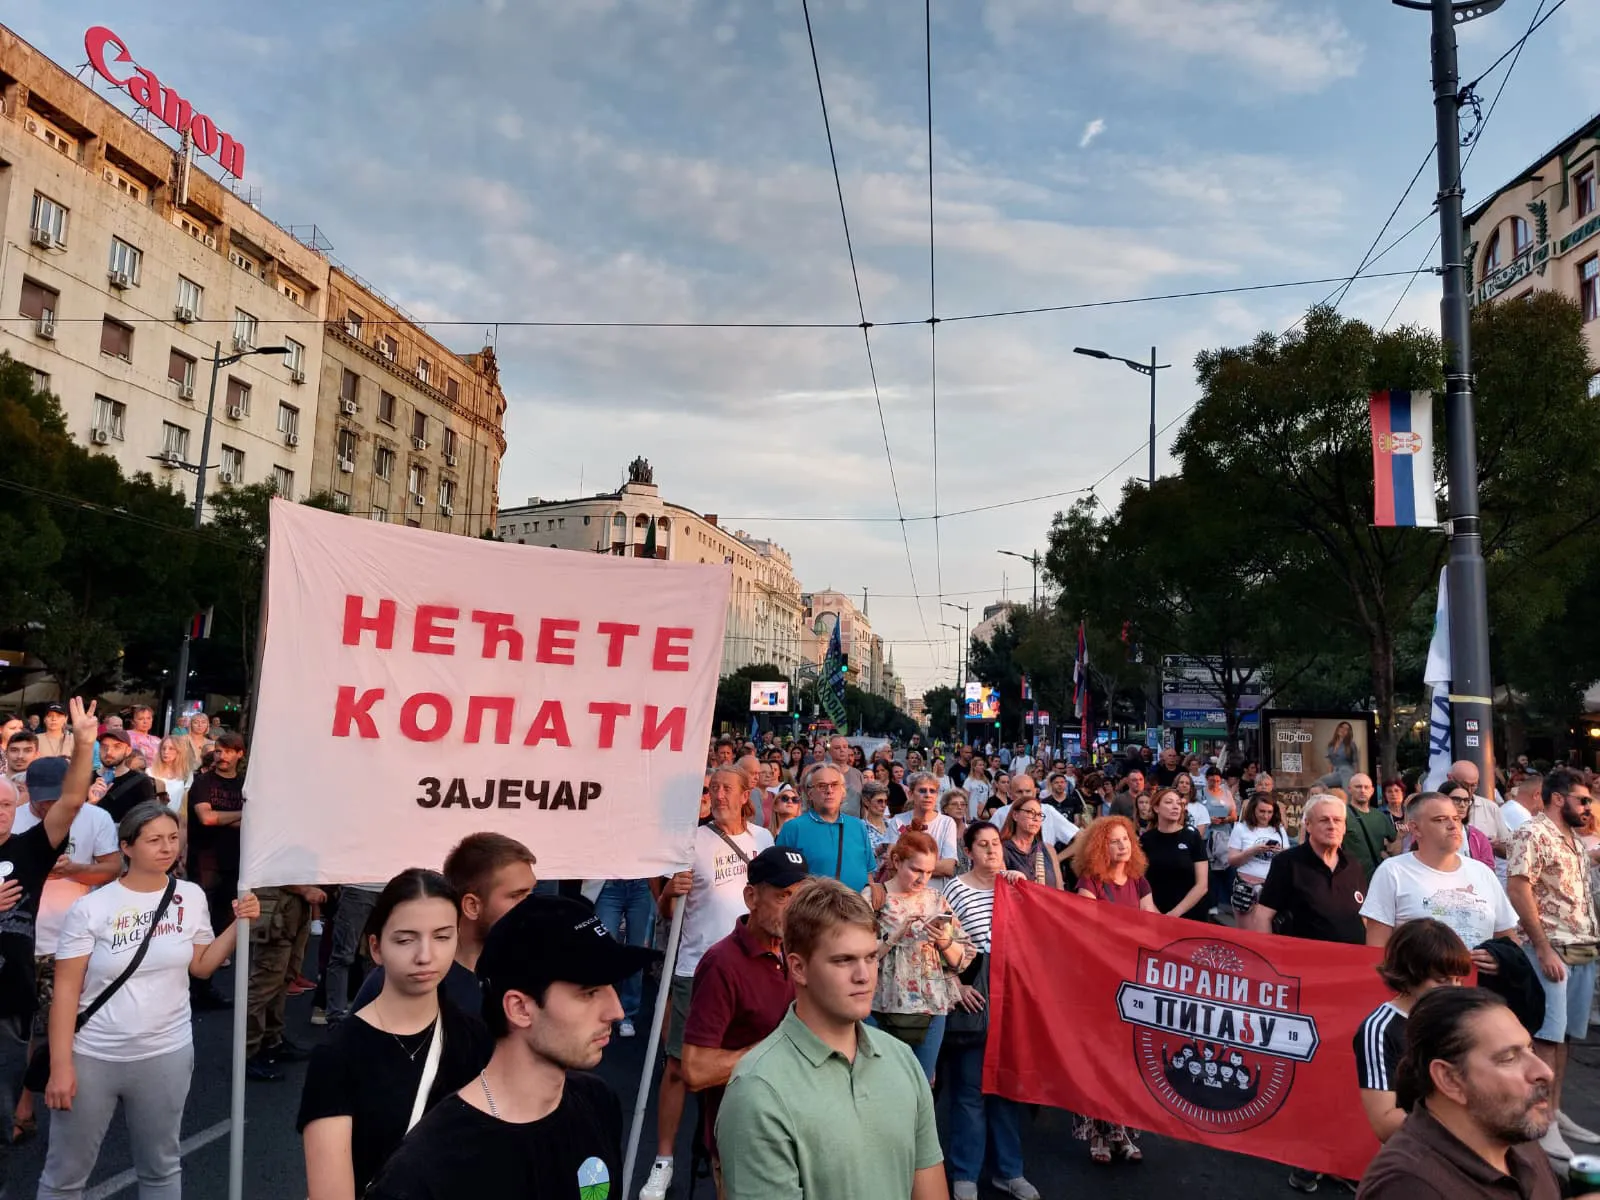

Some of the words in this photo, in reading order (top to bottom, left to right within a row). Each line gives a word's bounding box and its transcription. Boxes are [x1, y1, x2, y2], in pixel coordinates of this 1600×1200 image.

[84, 26, 245, 179] Canon
[342, 595, 694, 672] НЕЋЕТЕ
[332, 686, 687, 752] КОПАТИ
[416, 776, 602, 811] ЗАЈЕЧАР
[112, 933, 128, 949] ДА
[129, 929, 141, 942] СЕ
[116, 916, 130, 930] НЕ
[1146, 957, 1249, 1003] БОРАНИ
[1258, 981, 1290, 1010] СЕ
[1132, 999, 1144, 1010] 20
[1153, 995, 1276, 1047] ПИТАЈУ
[1288, 1030, 1298, 1042] 18
